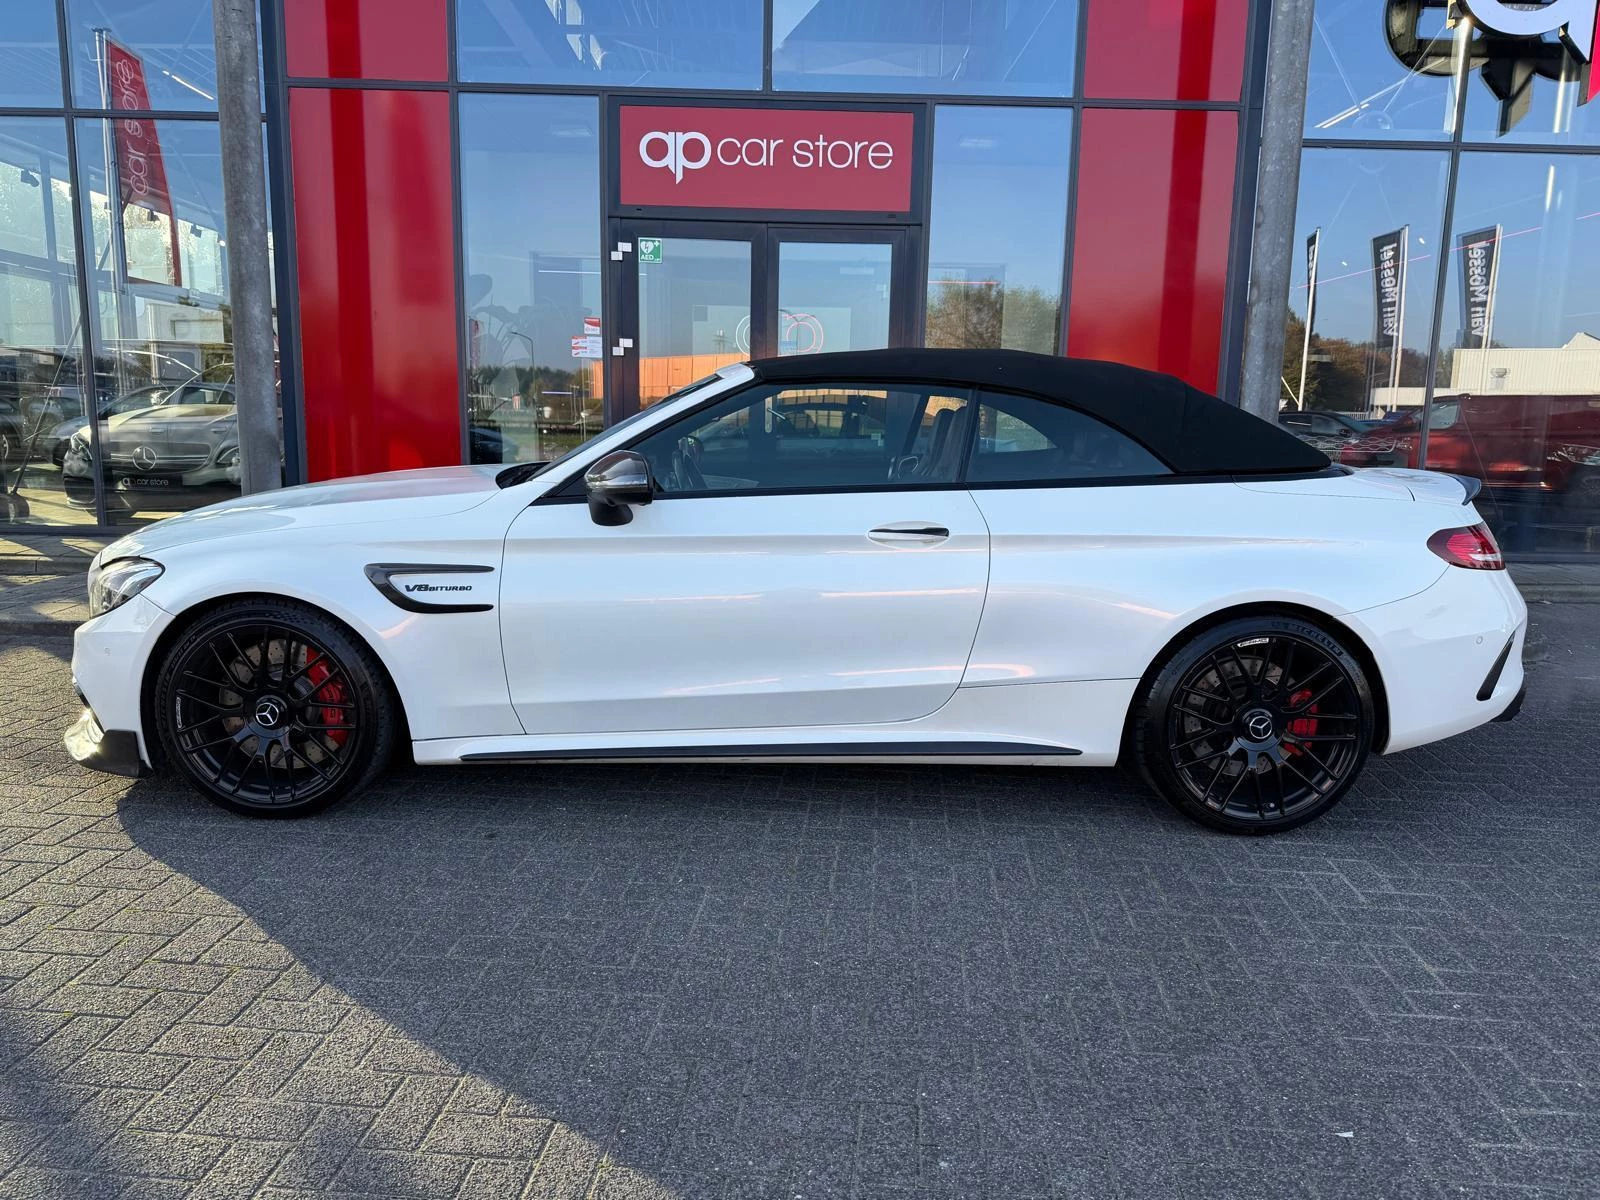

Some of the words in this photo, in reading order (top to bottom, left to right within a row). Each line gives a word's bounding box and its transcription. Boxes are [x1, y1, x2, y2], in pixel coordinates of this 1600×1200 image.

[116, 58, 143, 138] sore
[125, 140, 149, 195] car
[638, 130, 713, 185] ap
[717, 138, 783, 167] car
[793, 134, 894, 170] store
